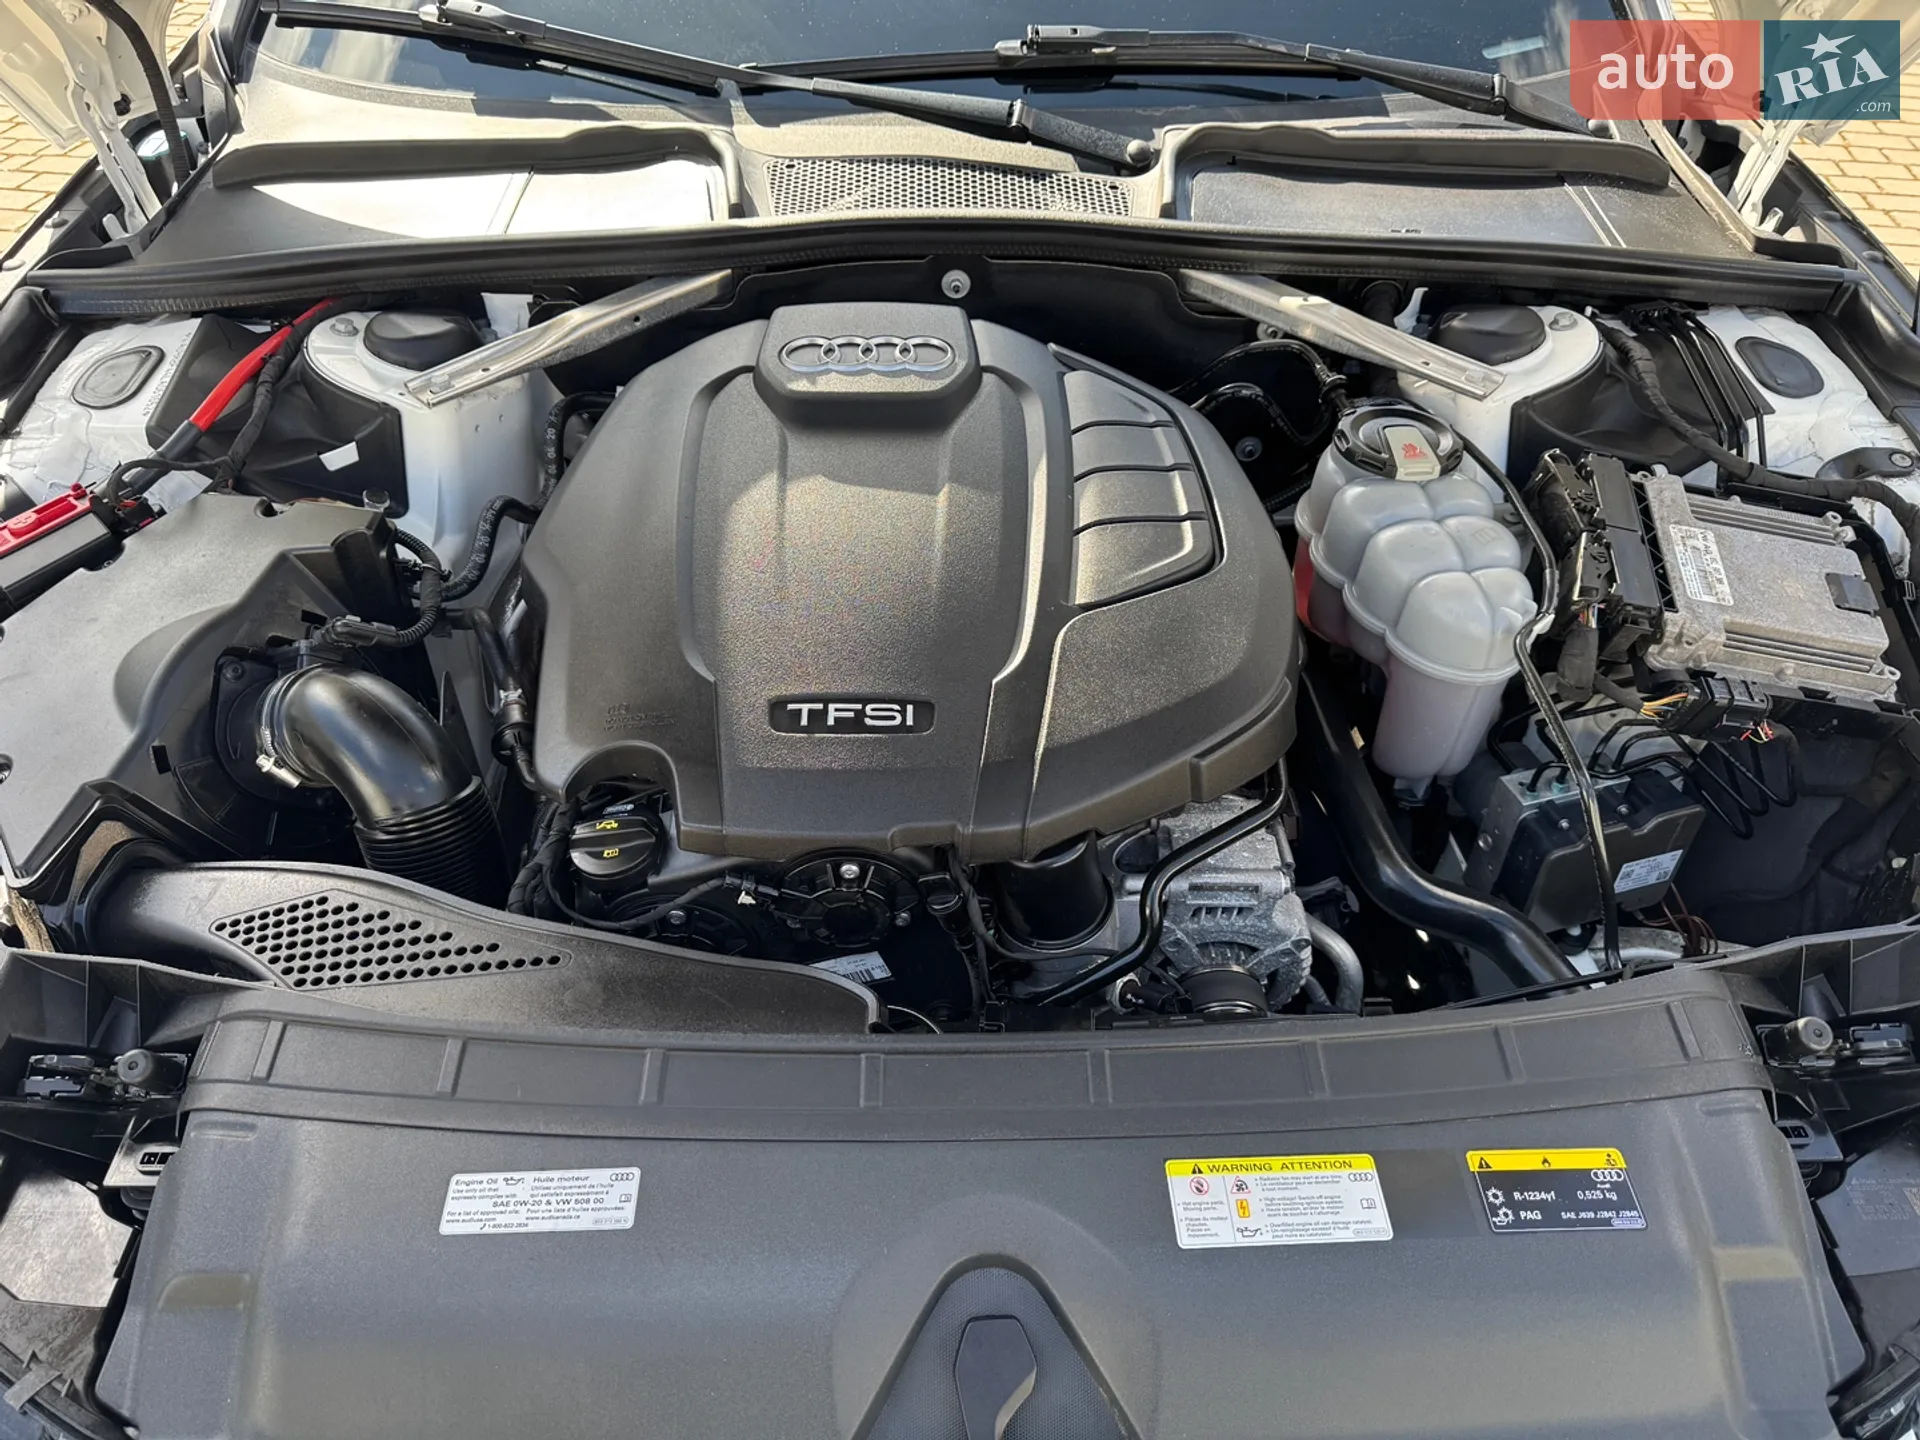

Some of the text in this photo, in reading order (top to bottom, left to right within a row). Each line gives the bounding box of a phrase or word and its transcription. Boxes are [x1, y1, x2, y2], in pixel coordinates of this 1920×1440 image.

[786, 703, 914, 727] TFSI
[1206, 1159, 1354, 1174] WARNING ATTENTION
[455, 1178, 484, 1186] Engine
[1513, 1190, 1556, 1202] R-1234yf
[1605, 1190, 1618, 1201] kg
[1519, 1210, 1542, 1220] PAG
